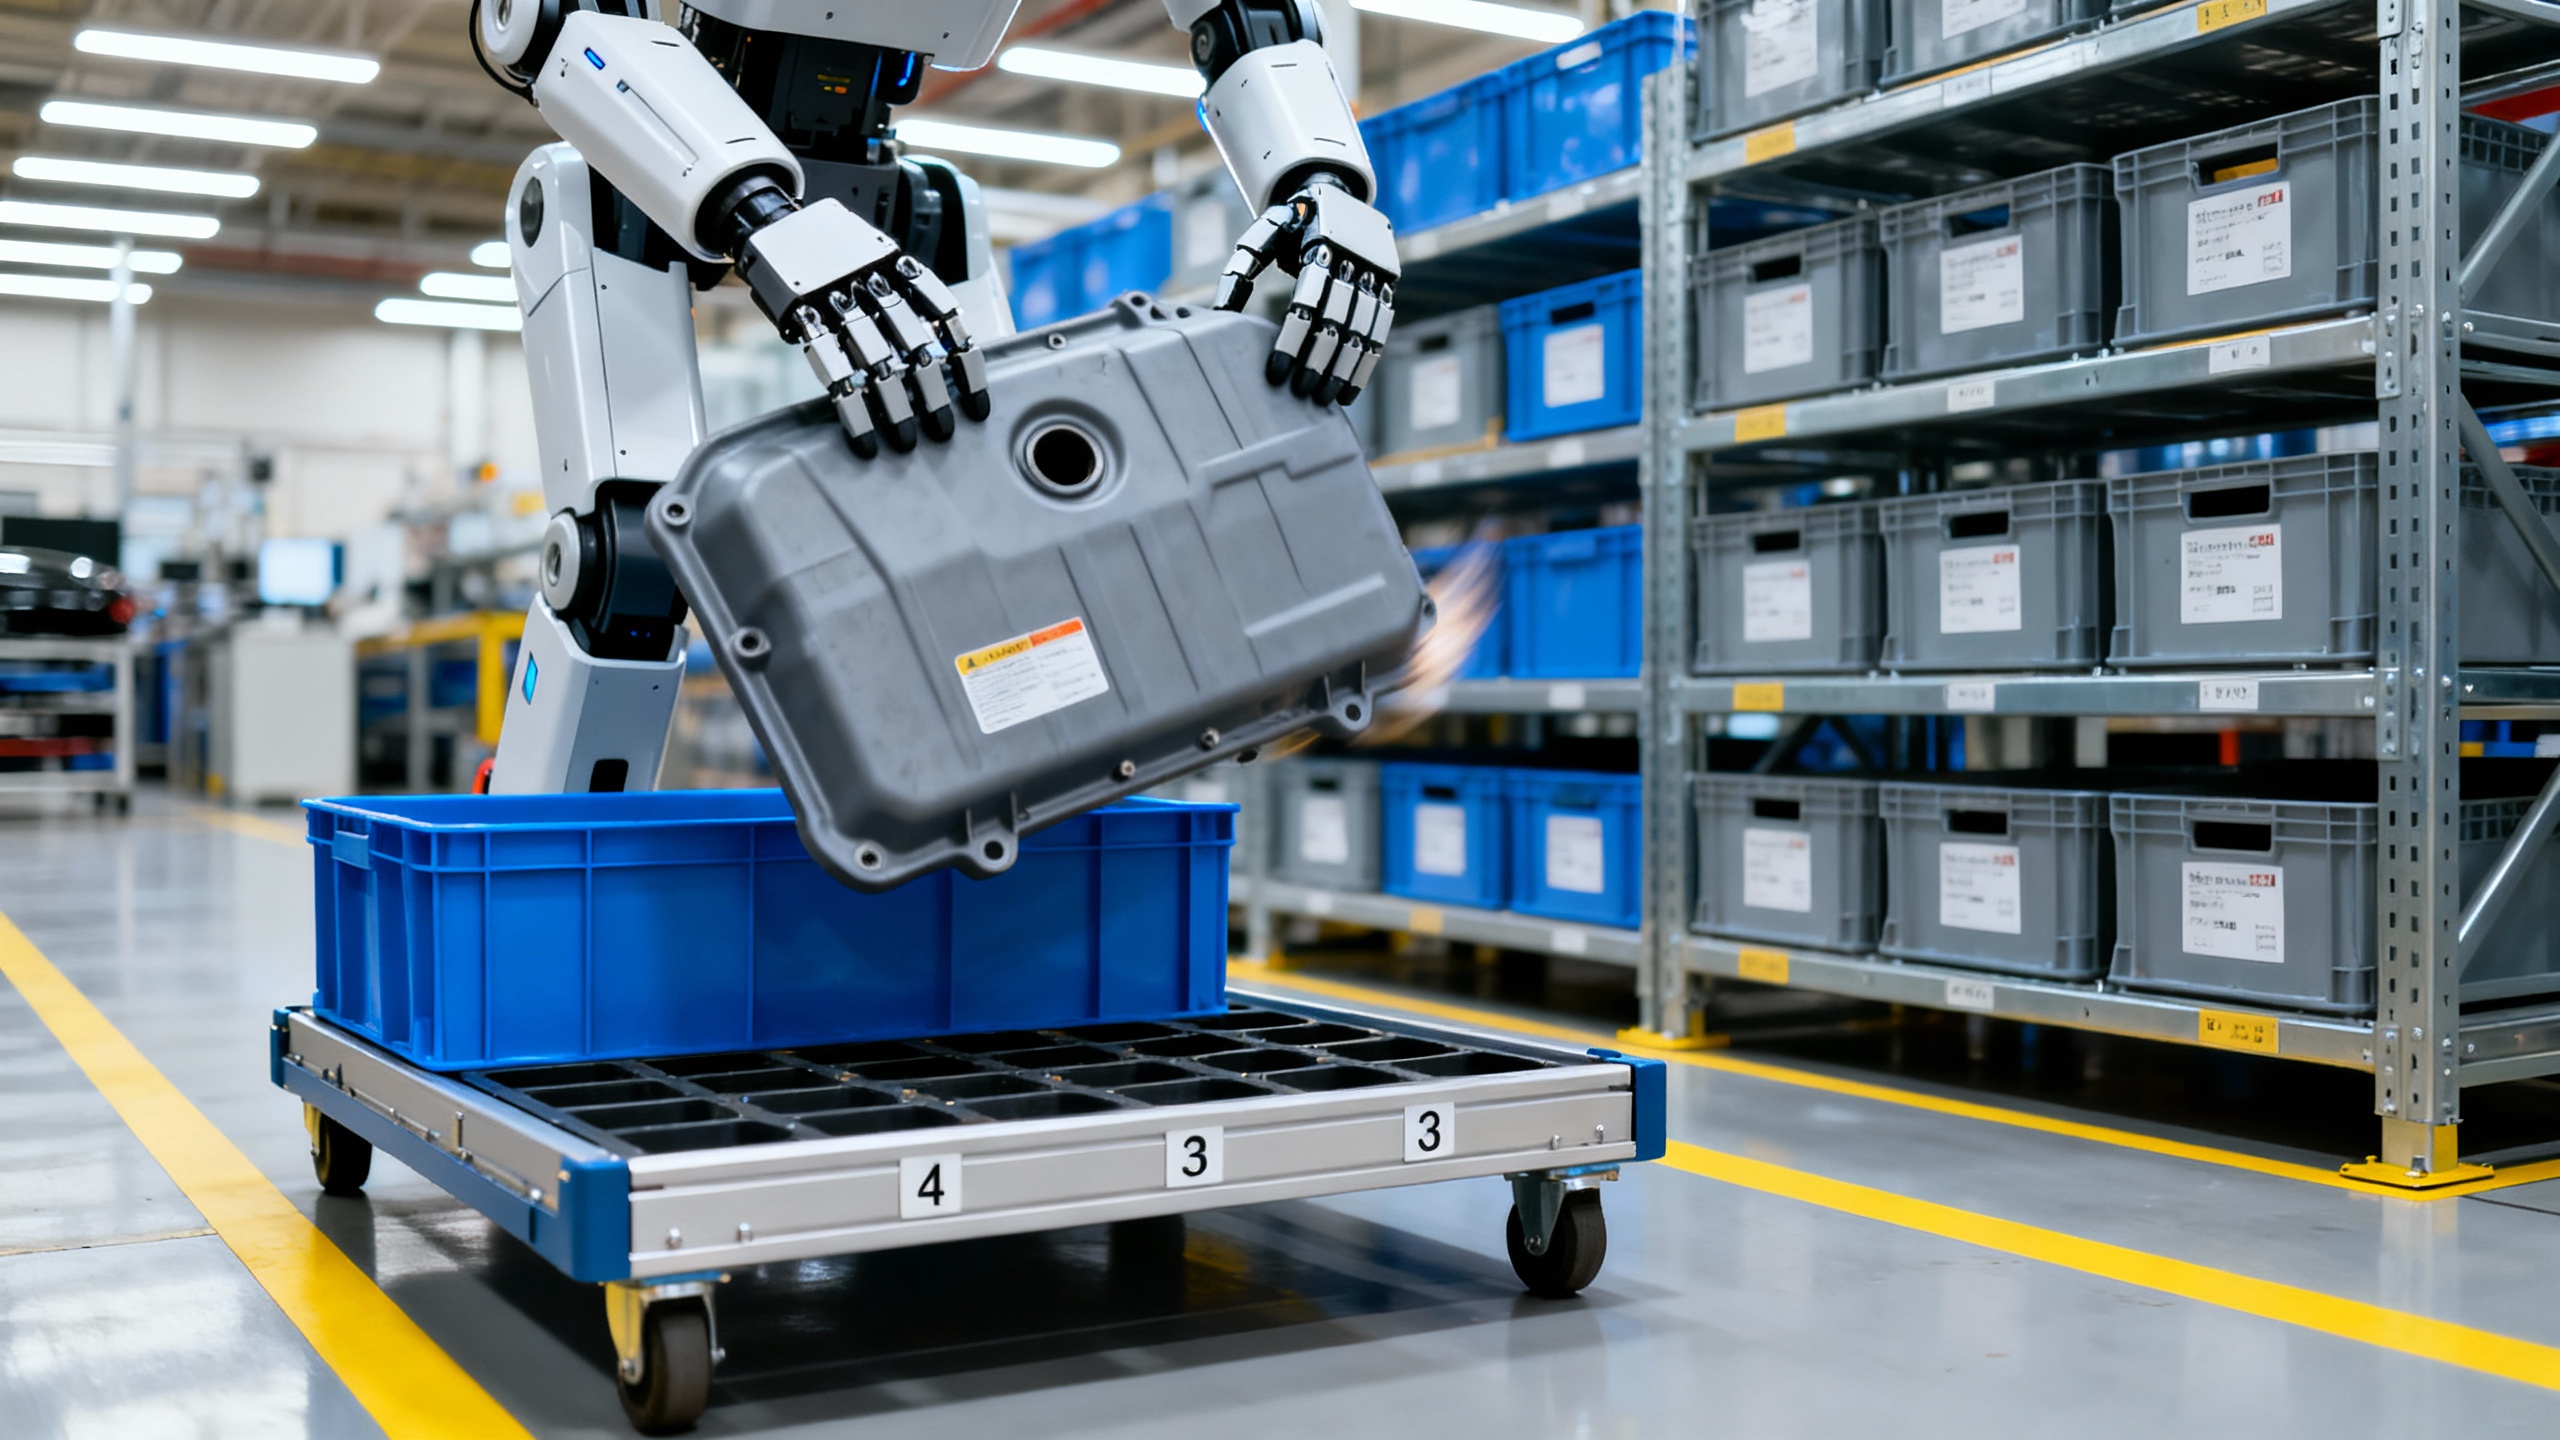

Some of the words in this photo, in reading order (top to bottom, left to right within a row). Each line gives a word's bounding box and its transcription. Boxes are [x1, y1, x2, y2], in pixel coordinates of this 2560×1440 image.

[1418, 1110, 1441, 1152] 3
[1182, 1135, 1208, 1178] 3
[917, 1163, 945, 1206] 4
